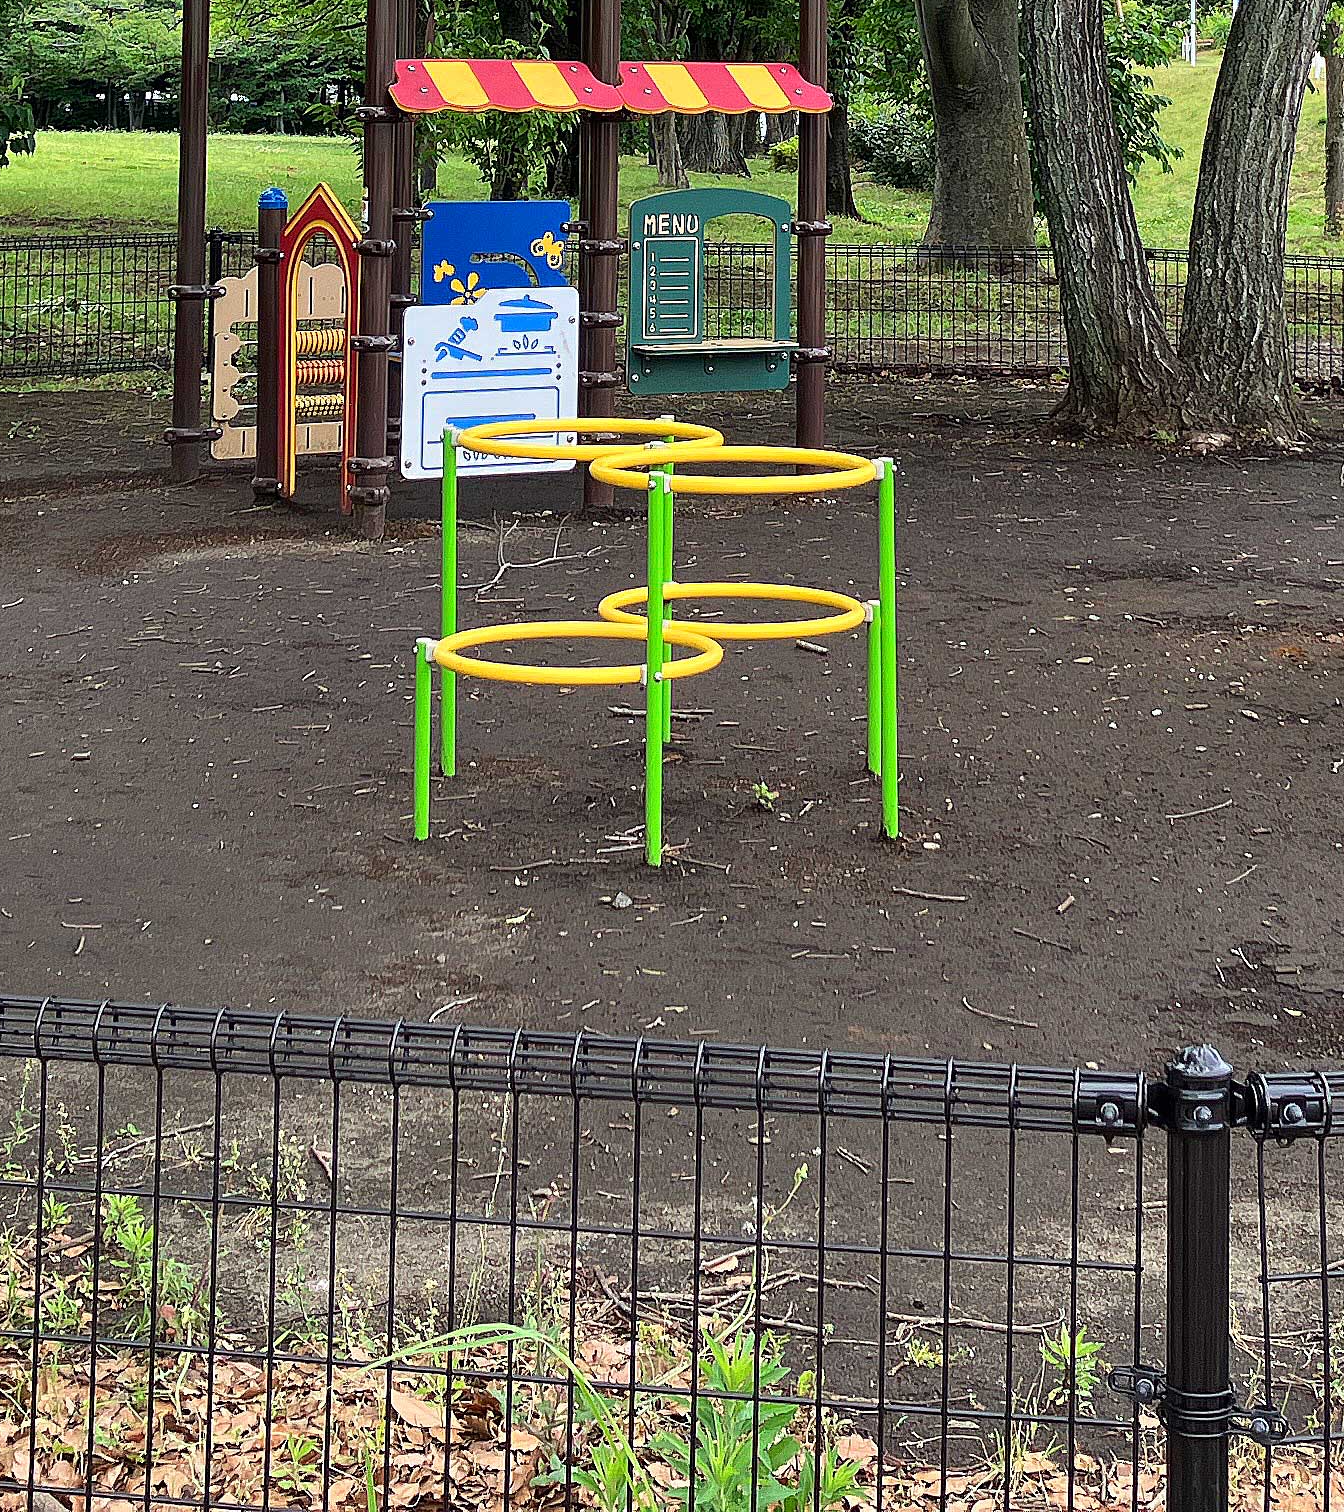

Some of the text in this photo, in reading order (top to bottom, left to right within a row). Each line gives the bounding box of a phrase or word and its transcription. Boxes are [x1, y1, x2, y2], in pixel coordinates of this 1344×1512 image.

[643, 213, 699, 235] MENU
[650, 252, 655, 262] 1
[649, 265, 656, 277] 2
[649, 279, 656, 291] 3
[649, 294, 656, 305] 4
[649, 307, 656, 319] 5
[649, 322, 656, 333] 6
